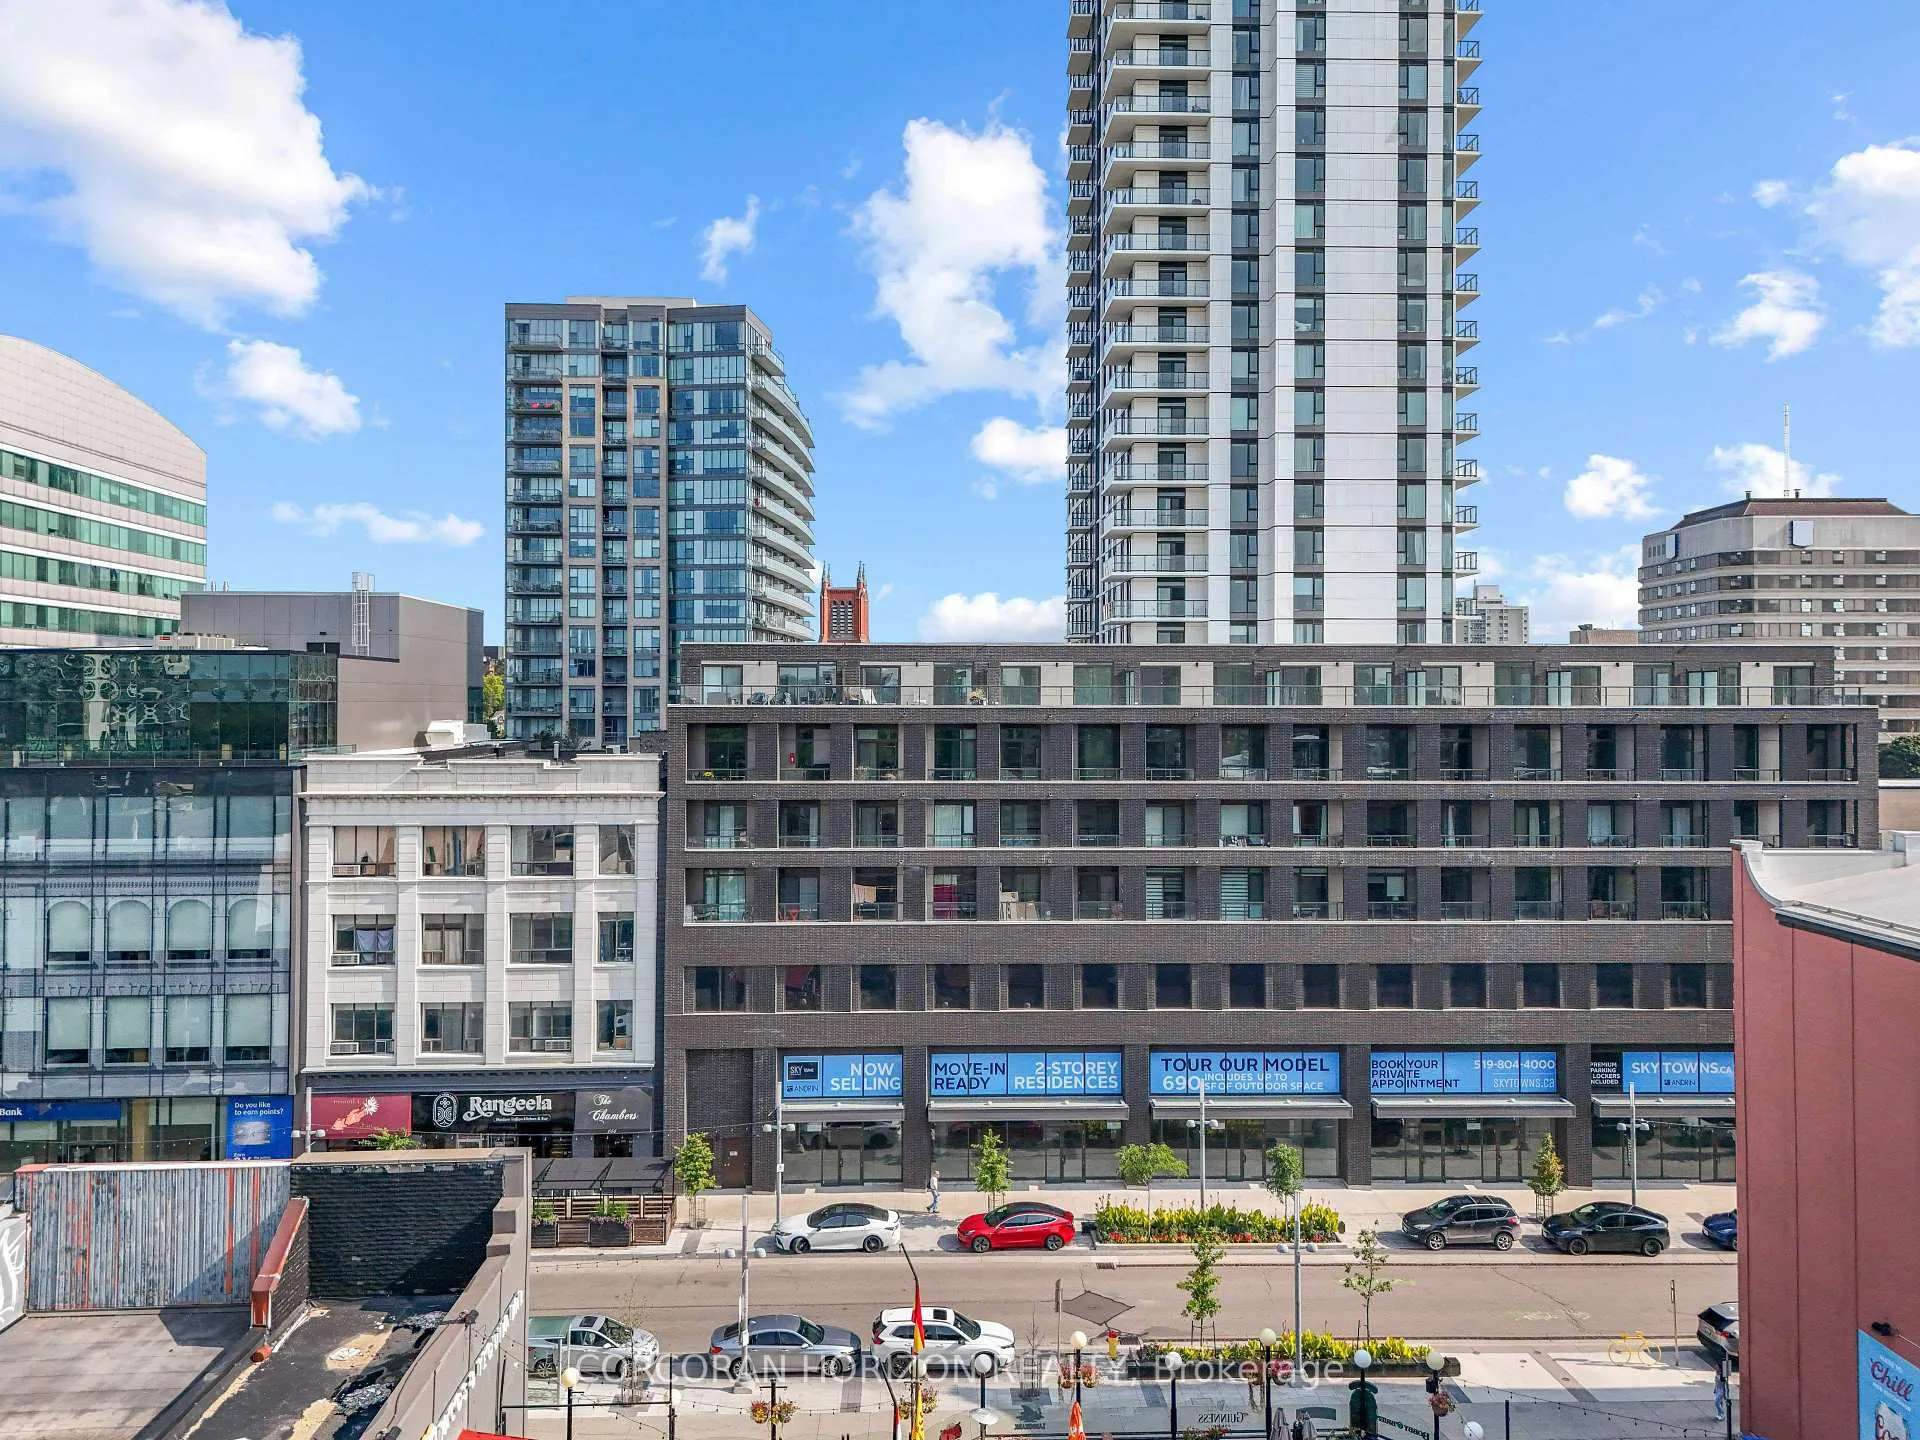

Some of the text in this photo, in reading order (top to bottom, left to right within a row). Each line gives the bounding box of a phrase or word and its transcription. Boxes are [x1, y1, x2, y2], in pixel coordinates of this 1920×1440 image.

[790, 1065, 802, 1075] SKY
[850, 1063, 895, 1076] NOW
[934, 1062, 1006, 1076] MOVE-IN
[1034, 1061, 1118, 1075] 2-STOREY
[1161, 1058, 1330, 1071] TOUR OUR MODEL
[1371, 1060, 1439, 1069] BOOK YOUR
[1474, 1059, 1555, 1069] 519-804-4000
[1204, 1073, 1287, 1081] INCLUDES UP TO
[1371, 1069, 1420, 1079] PRIVATE
[830, 1077, 901, 1091] SELLING
[934, 1077, 991, 1090] READY
[1014, 1075, 1118, 1089] RESIDENCES
[1162, 1075, 1200, 1091] 690
[1204, 1082, 1324, 1090] SF OF OUTDOOR SPACE
[1371, 1079, 1460, 1088] APPOINTMENT
[794, 1085, 819, 1093] ANDRIN
[245, 1102, 258, 1110] you
[593, 1094, 612, 1106] The
[0, 1107, 23, 1116] Bank
[259, 1107, 284, 1117] points?
[462, 1094, 553, 1122] Rangeela
[588, 1107, 639, 1121] Chambers
[1870, 1357, 1913, 1402] Chill
